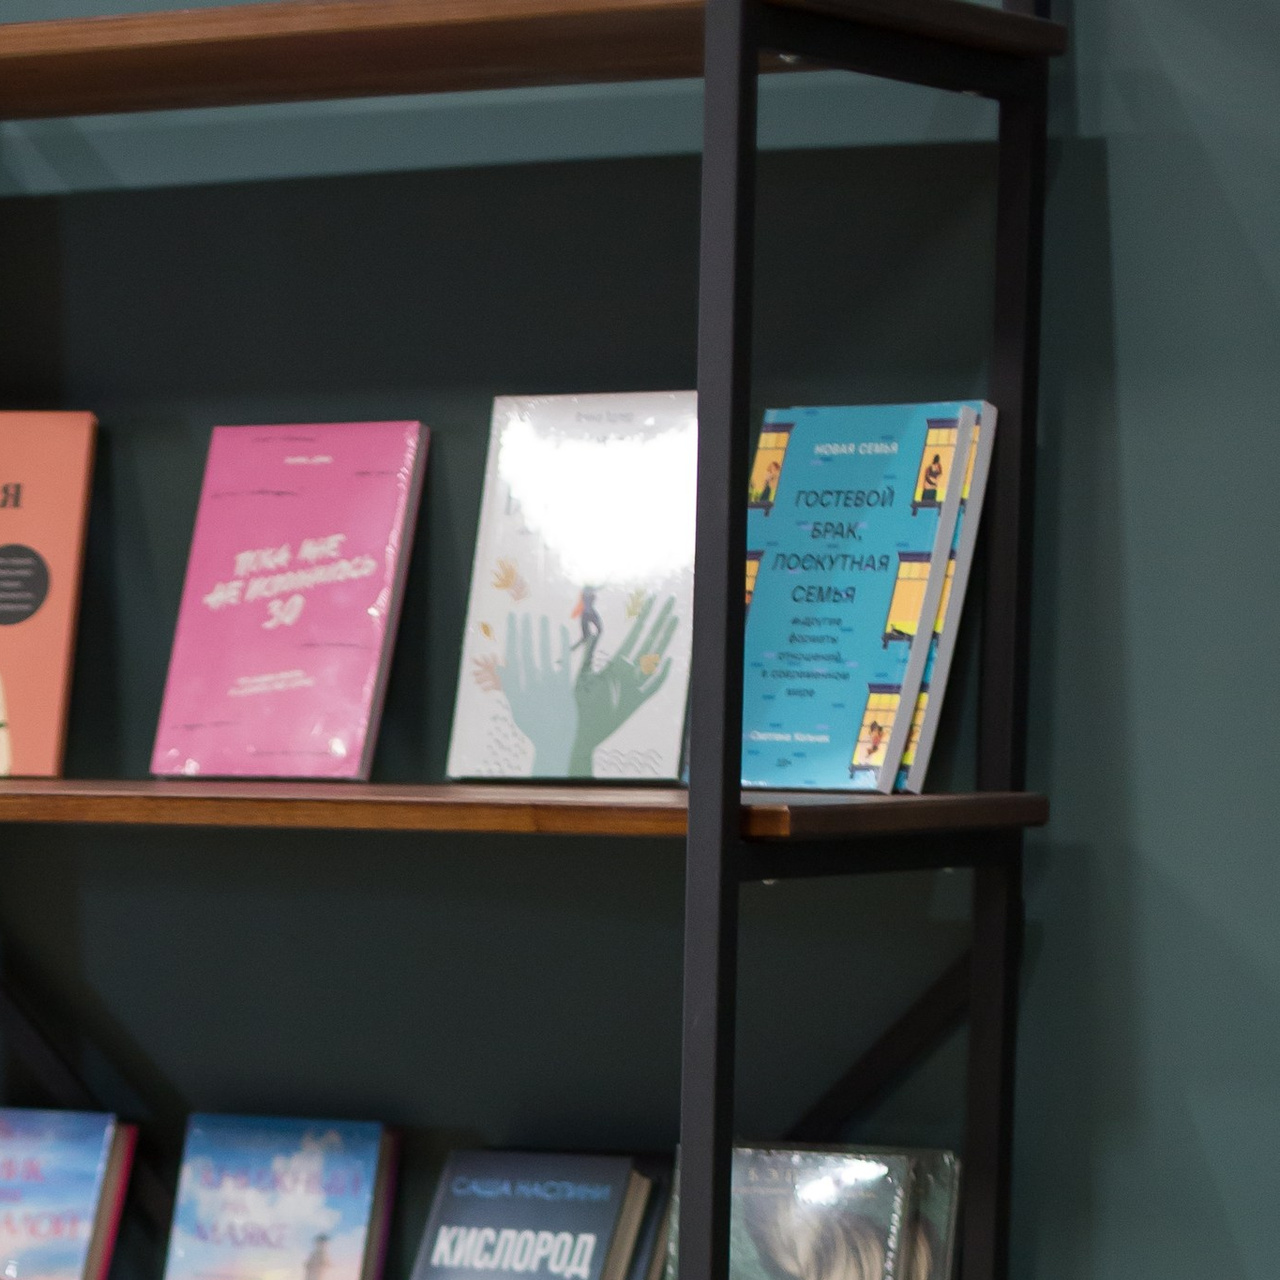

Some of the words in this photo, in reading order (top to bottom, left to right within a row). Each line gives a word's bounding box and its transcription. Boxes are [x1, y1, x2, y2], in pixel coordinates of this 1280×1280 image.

[814, 442, 856, 456] НОВАЯ
[858, 442, 899, 455] СЕМЬЯ
[0, 483, 22, 508] Я
[794, 486, 895, 508] ГОСТЕВОЙ
[811, 521, 862, 541] БРАК,
[772, 553, 890, 572] ЛОСКУТНАЯ
[791, 585, 856, 603] СЕМЬЯ
[430, 1225, 598, 1280] КИСЛОРОД
